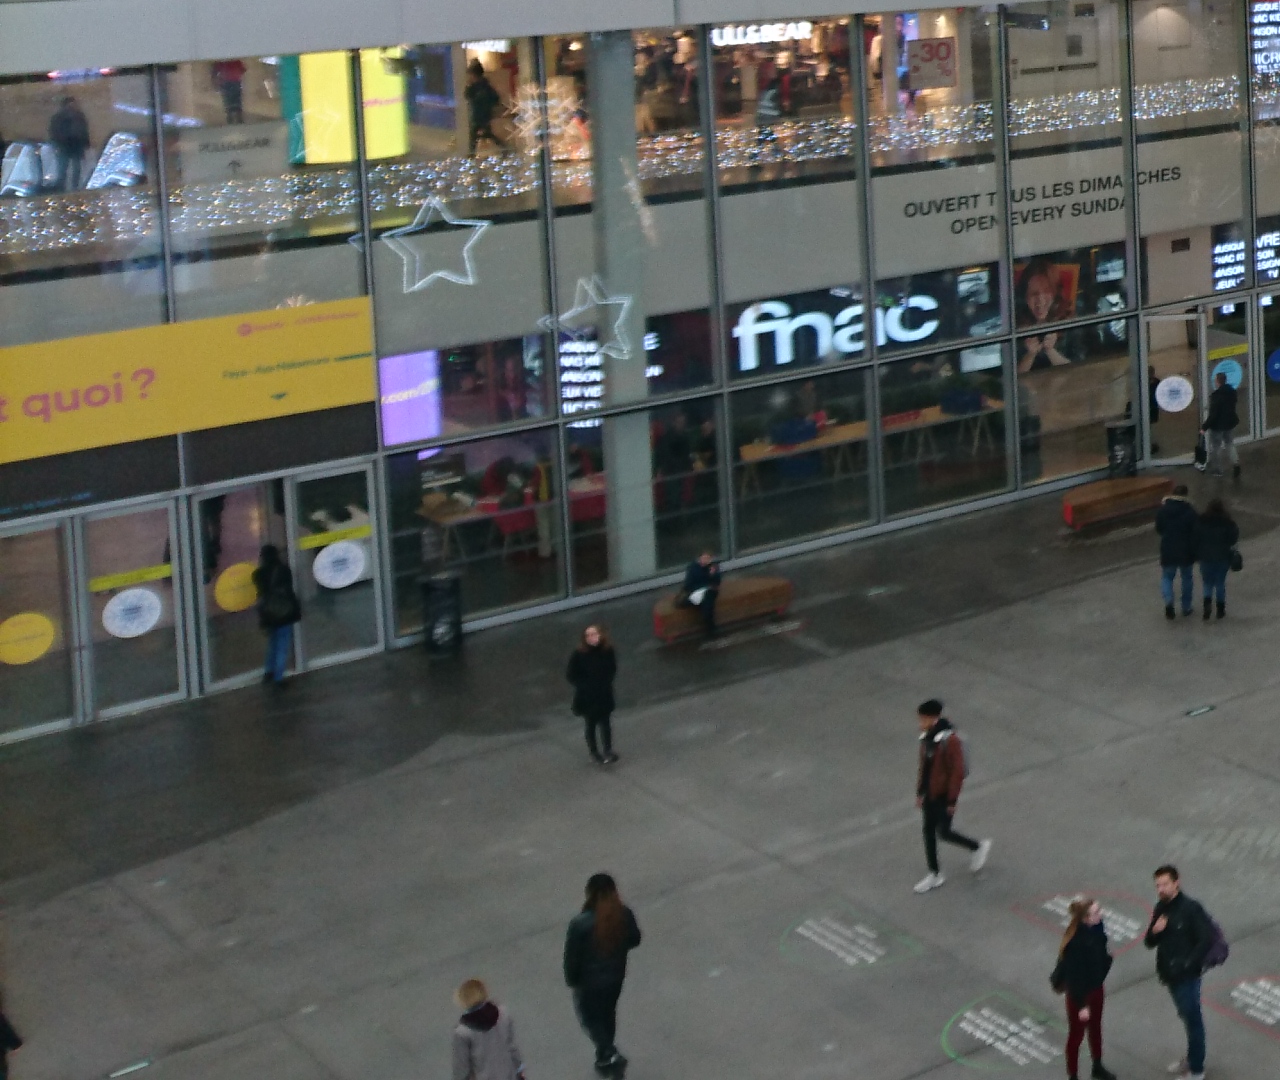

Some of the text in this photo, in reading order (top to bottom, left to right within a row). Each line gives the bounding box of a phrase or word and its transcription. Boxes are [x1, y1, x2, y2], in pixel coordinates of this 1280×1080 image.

[904, 166, 1182, 218] OUVERT TUS LES DIMACHES
[733, 294, 940, 371] fnac
[21, 372, 124, 423] quoi
[131, 368, 156, 400] ?
